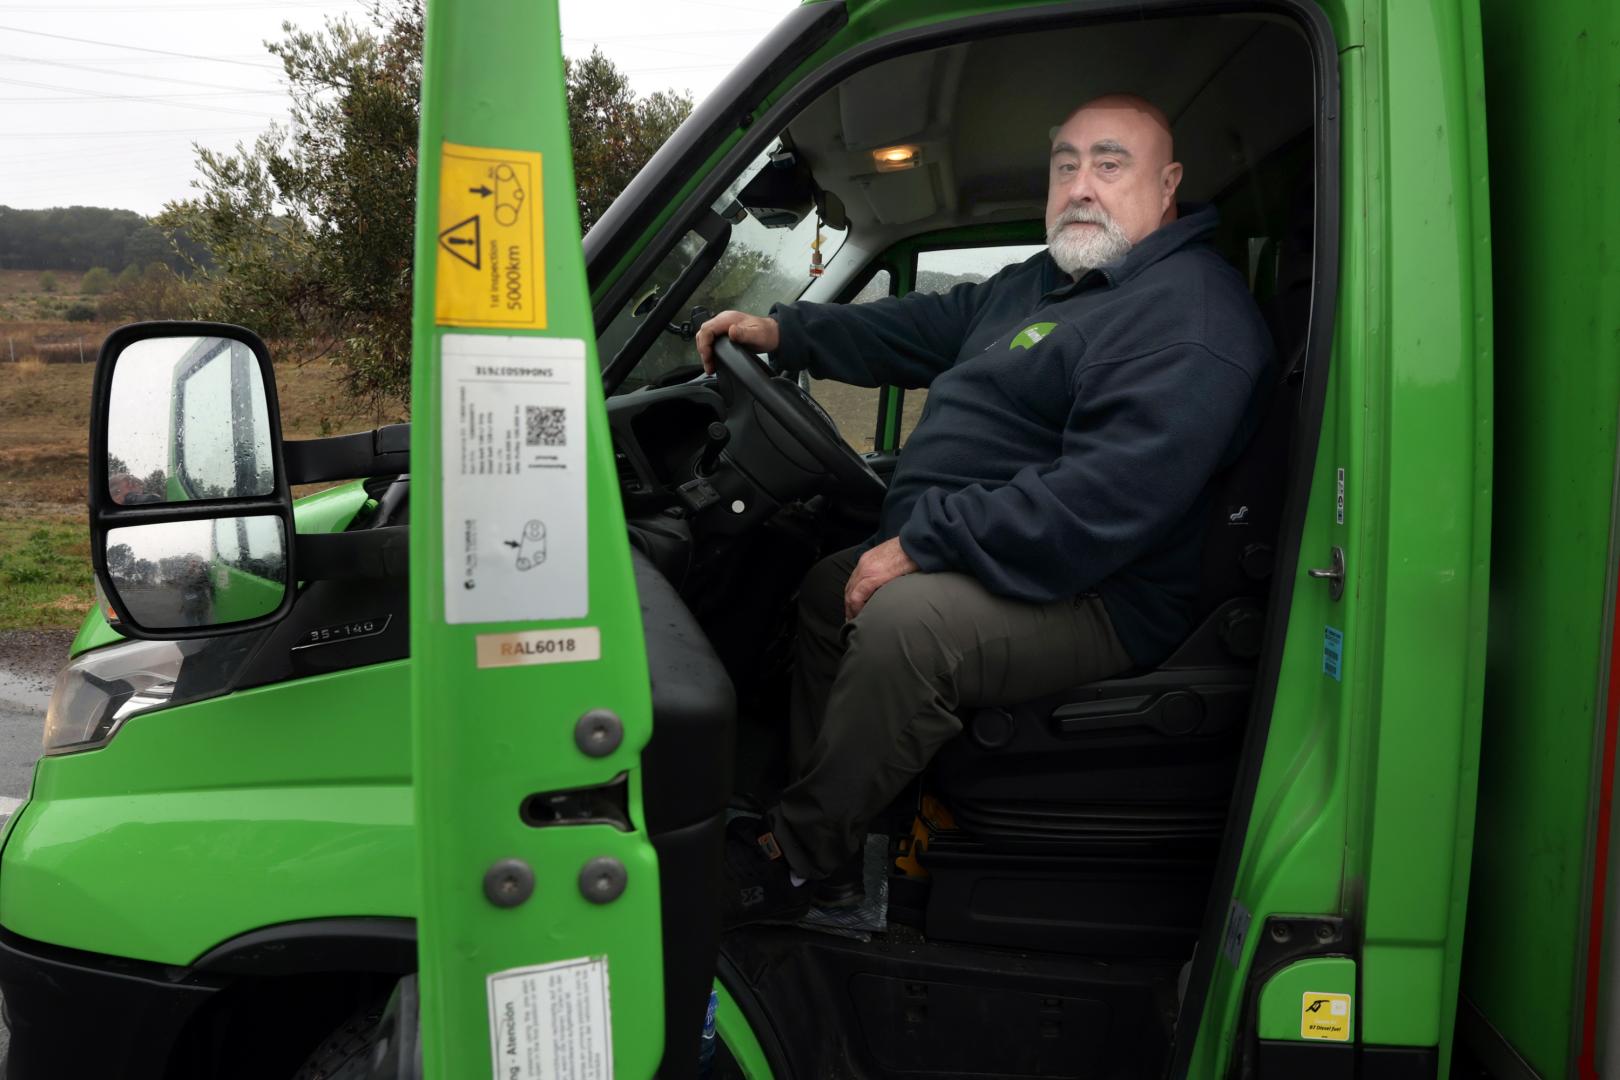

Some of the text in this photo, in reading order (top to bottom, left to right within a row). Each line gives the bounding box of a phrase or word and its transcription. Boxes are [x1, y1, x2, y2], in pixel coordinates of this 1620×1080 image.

[490, 240, 501, 291] inspection
[506, 245, 522, 311] 5000km
[311, 622, 374, 640] 35-140
[501, 638, 576, 655] RAL6018
